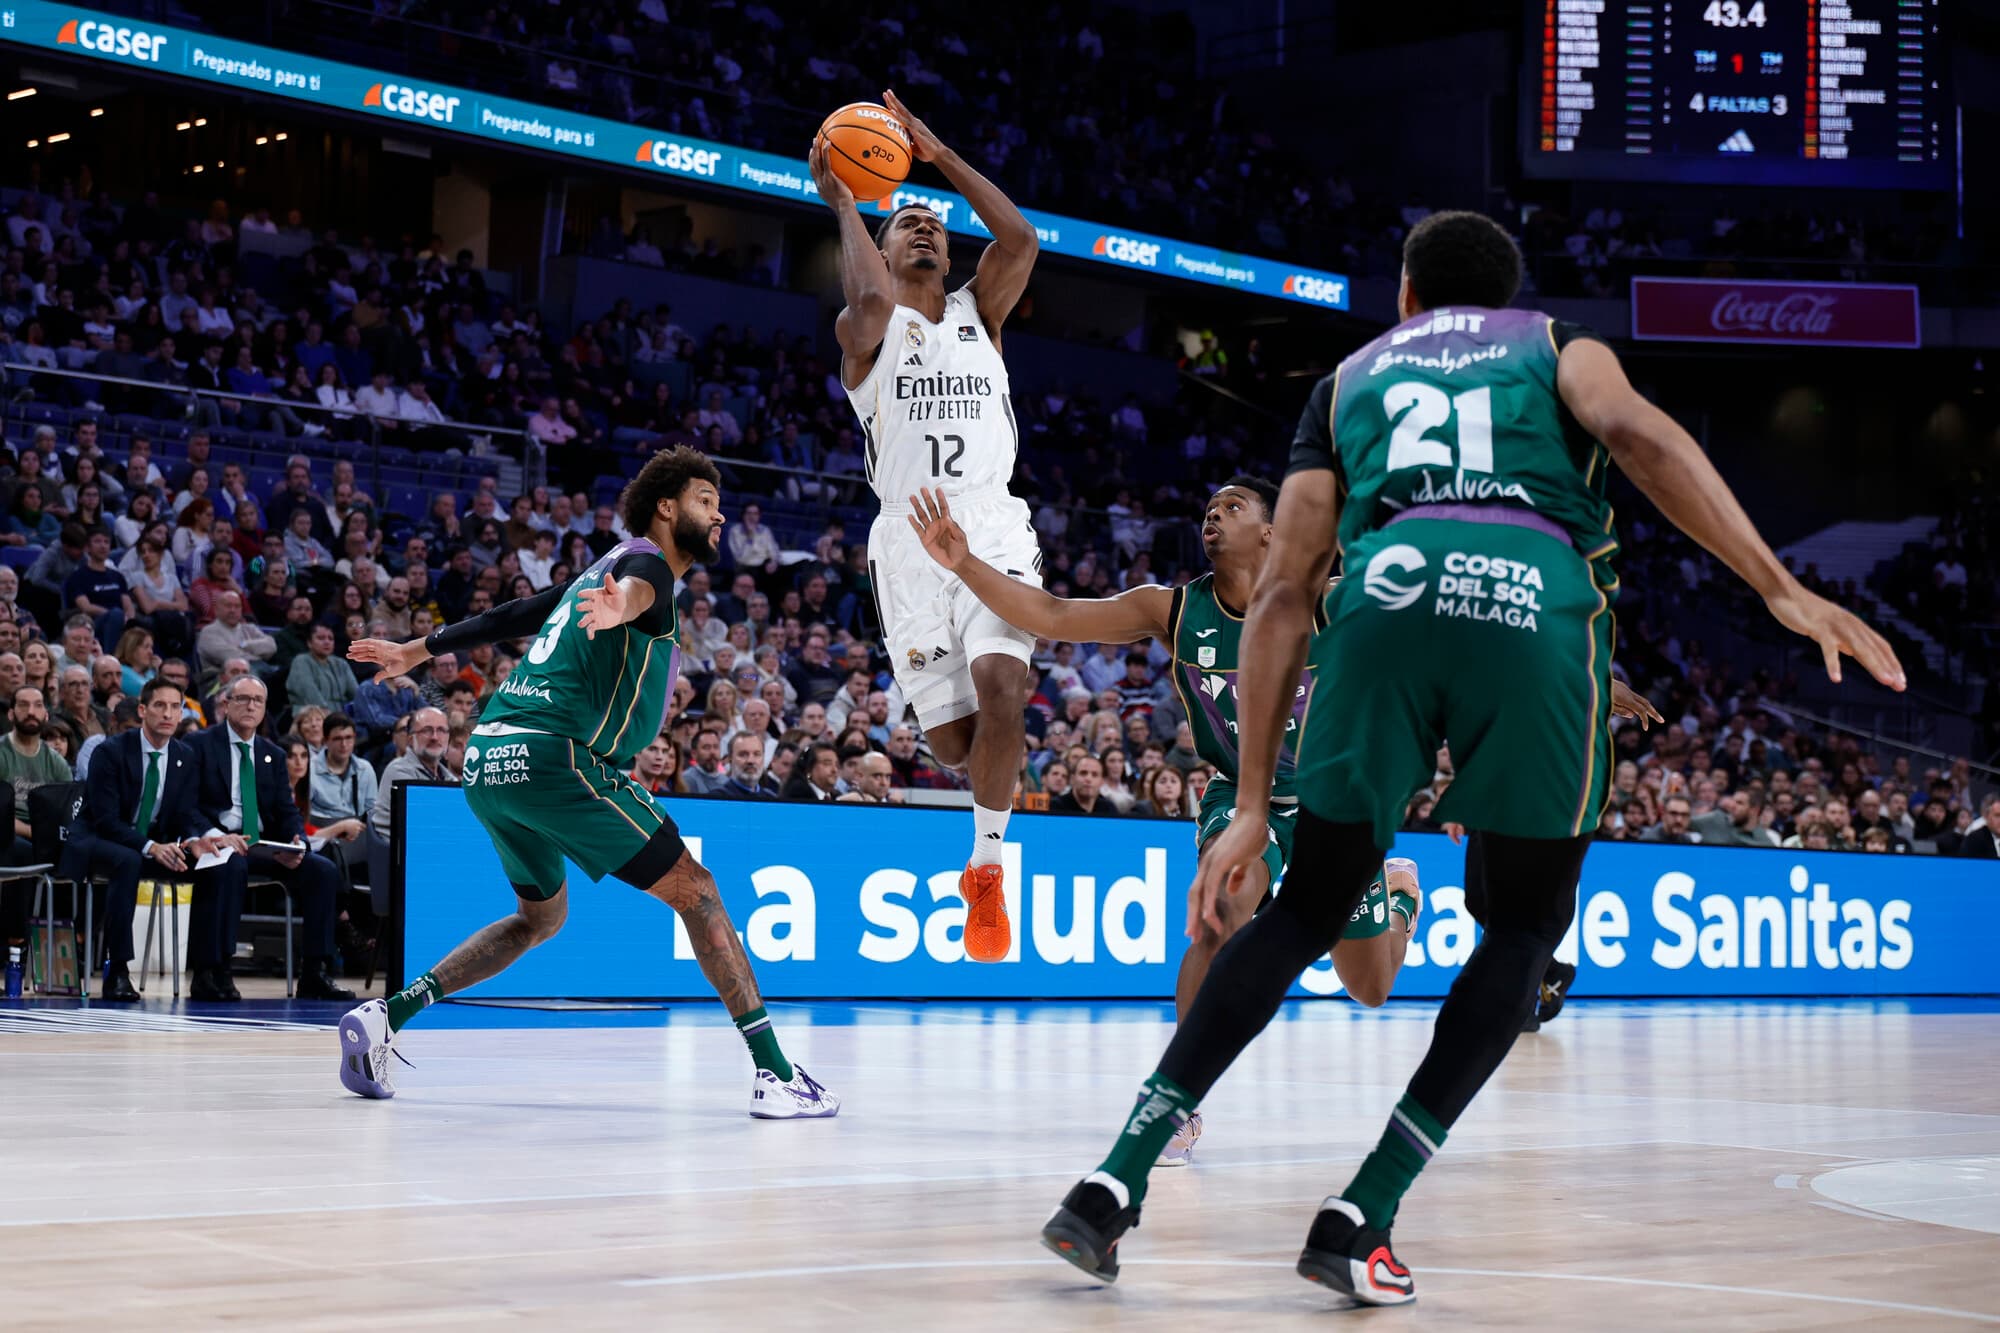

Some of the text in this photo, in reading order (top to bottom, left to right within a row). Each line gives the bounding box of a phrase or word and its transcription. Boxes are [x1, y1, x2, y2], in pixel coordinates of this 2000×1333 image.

[1703, 0, 1767, 28] 43.4
[79, 20, 168, 62] caser
[193, 48, 321, 91] Preparados para ti
[1730, 53, 1743, 75] 1
[382, 84, 460, 123] caser
[1689, 92, 1705, 113] 4
[1708, 96, 1770, 113] FALTAS
[1772, 94, 1788, 116] 3
[482, 109, 595, 147] Preparados para ti
[652, 139, 721, 177] caser
[740, 162, 802, 190] Preparados
[891, 191, 954, 224] caser
[1106, 236, 1160, 268] caser
[1293, 274, 1343, 304] caser
[896, 371, 992, 400] Emirates
[909, 400, 982, 422] FLY BETTER
[1383, 381, 1494, 473] 21
[924, 434, 966, 478] 12
[1443, 551, 1544, 592] COSTA
[1438, 574, 1542, 612] DEL SOL
[1434, 594, 1538, 633] MÁLAGA
[528, 600, 571, 665] 3
[498, 674, 554, 704] ndalucía
[483, 757, 530, 773] DEL SOL
[485, 743, 530, 760] COSTA
[484, 770, 530, 787] MÁLAGA
[858, 841, 1167, 965] salud
[1652, 865, 1914, 970] Sanitas
